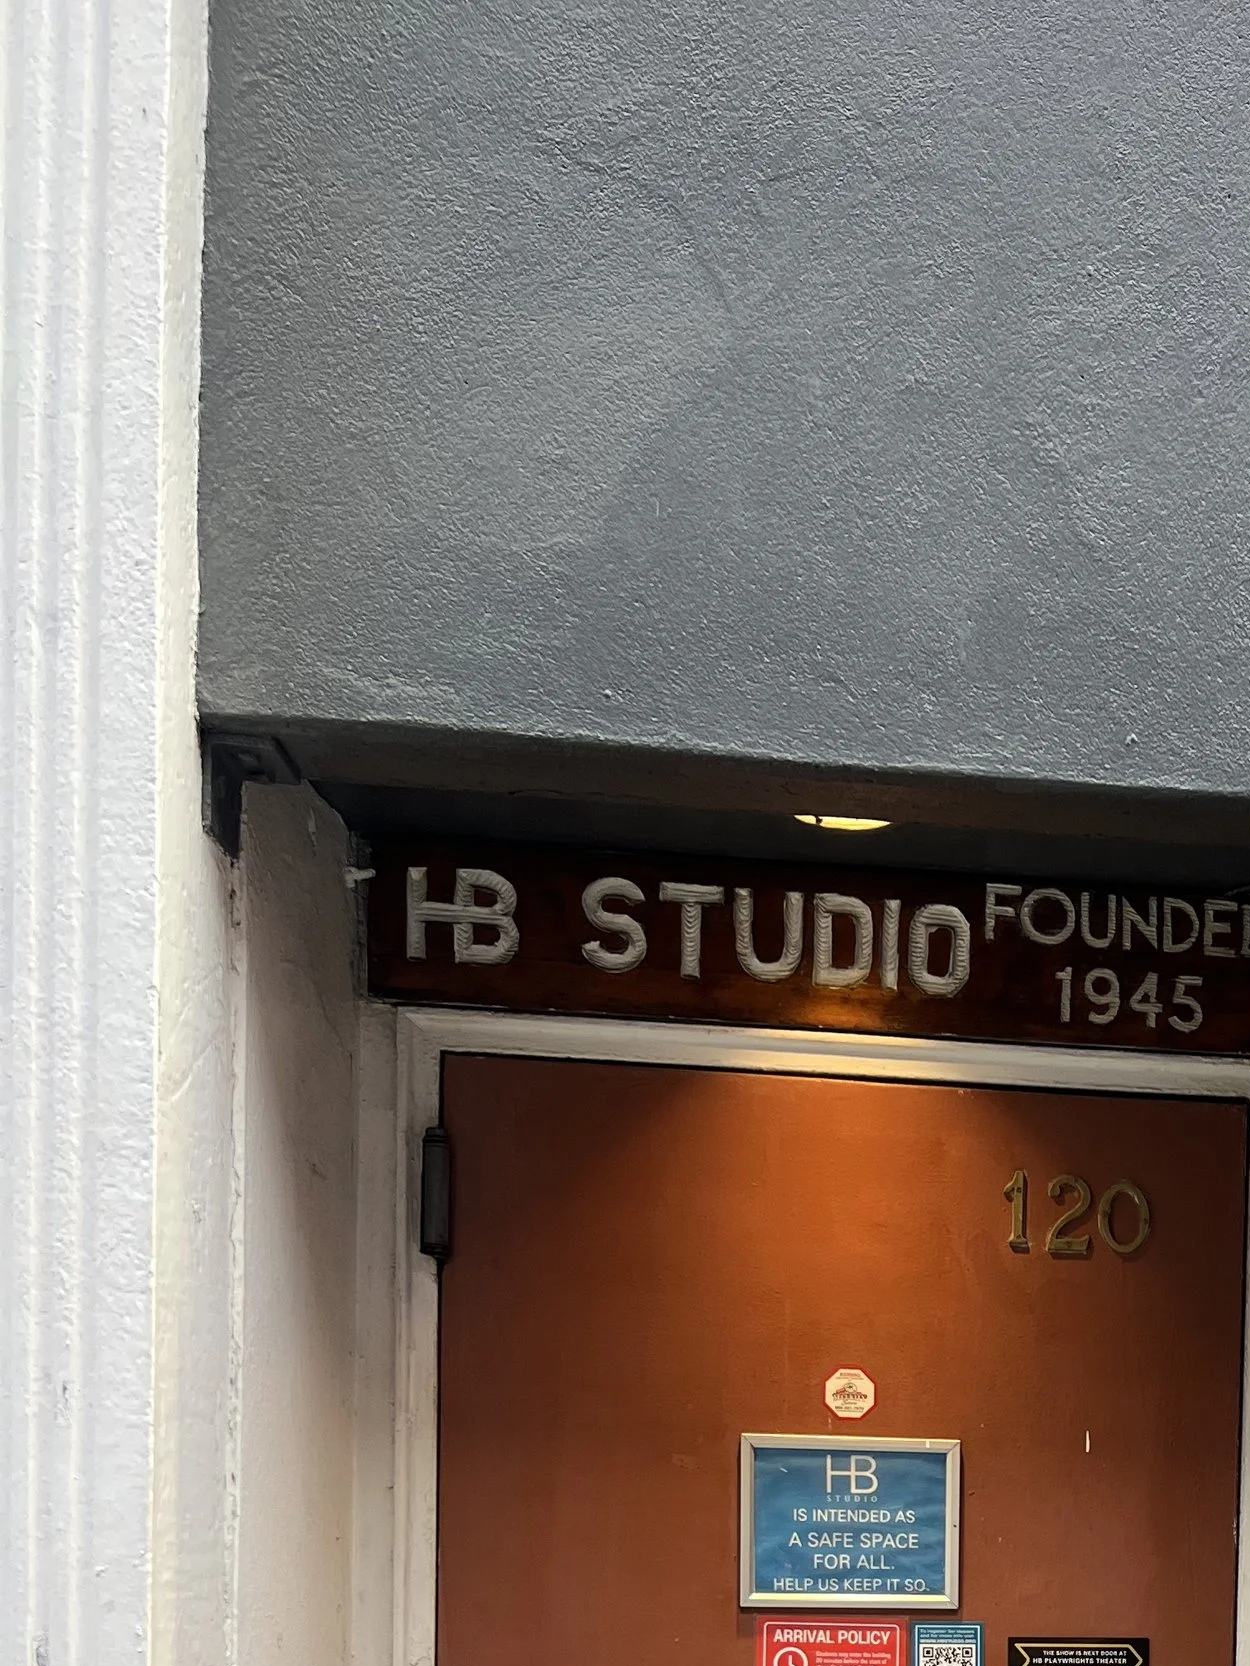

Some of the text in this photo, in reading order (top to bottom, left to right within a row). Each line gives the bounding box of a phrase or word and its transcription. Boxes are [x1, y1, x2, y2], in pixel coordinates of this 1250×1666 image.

[406, 866, 973, 998] HB STUDIO
[1055, 966, 1203, 1034] 1945
[1003, 1169, 1150, 1256] 120
[826, 1454, 879, 1494] HB
[827, 1495, 878, 1503] STUDIO
[793, 1508, 916, 1524] IS INTENDED AS
[788, 1532, 919, 1549] A SAFE SPACE
[813, 1554, 895, 1570] FOR ALL.
[773, 1578, 814, 1591] HELP
[818, 1578, 839, 1592] US
[844, 1578, 882, 1591] KEEP
[887, 1579, 900, 1591] IT
[773, 1628, 891, 1645] ARRIVAL POLICY
